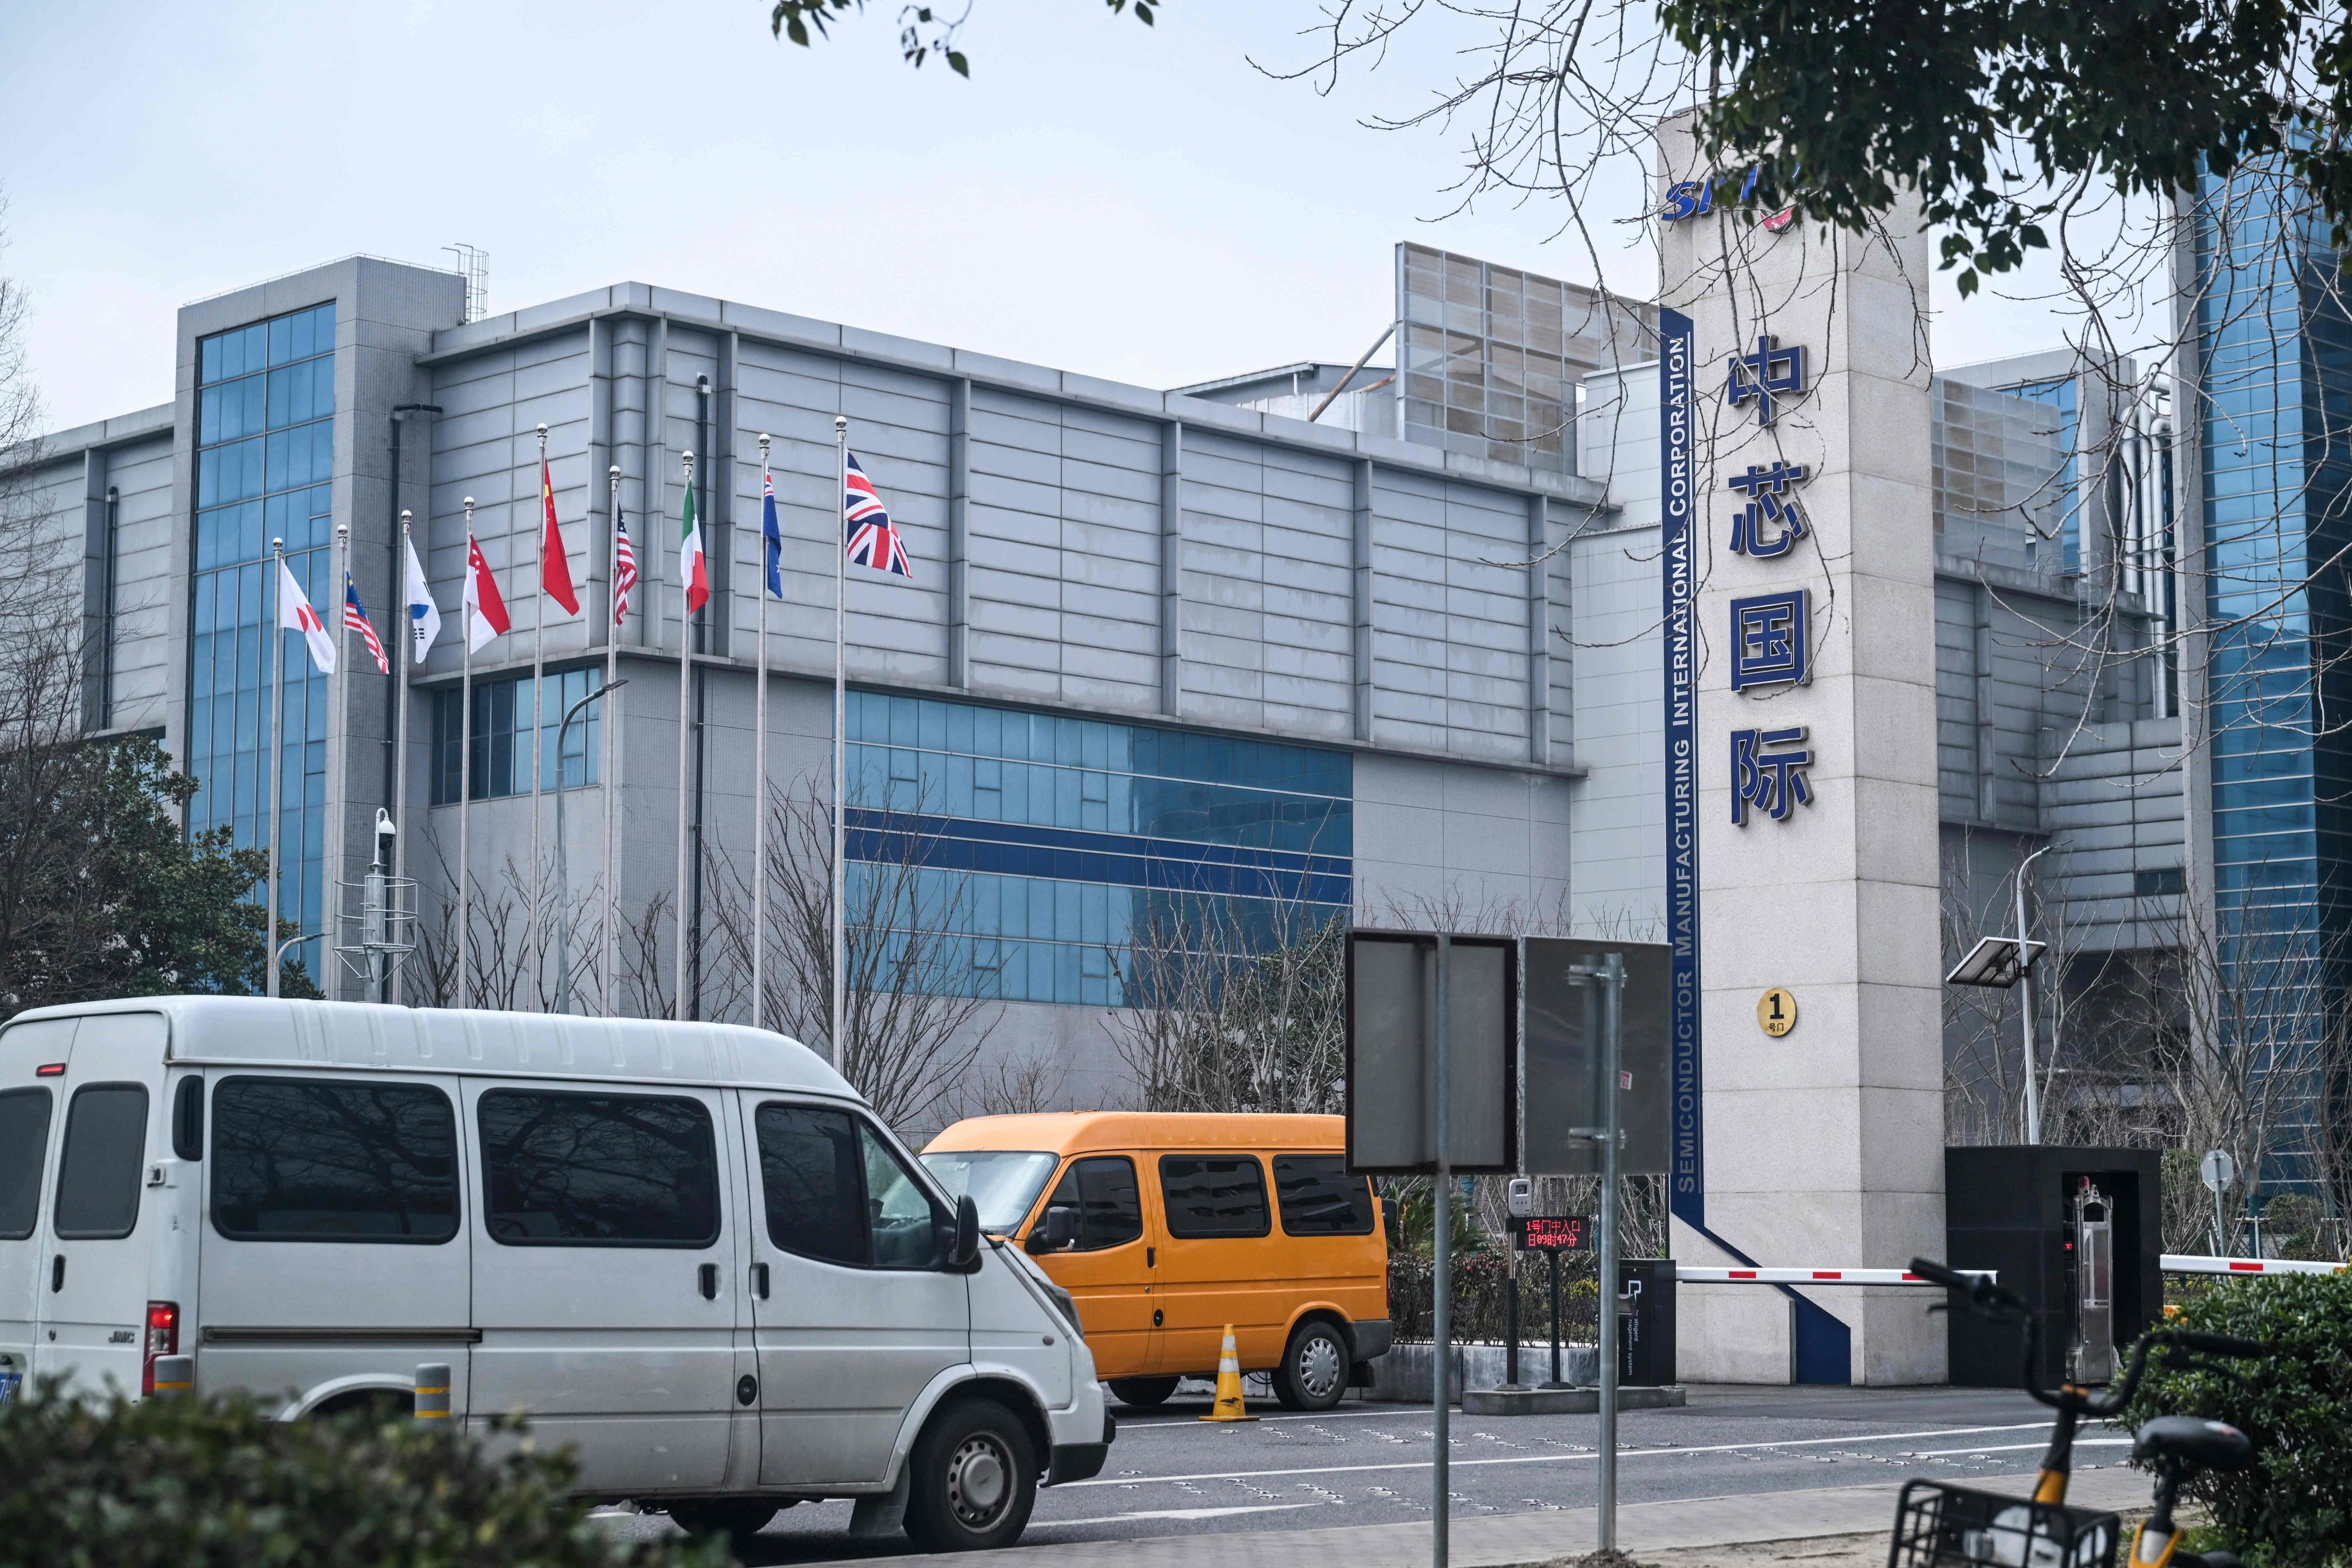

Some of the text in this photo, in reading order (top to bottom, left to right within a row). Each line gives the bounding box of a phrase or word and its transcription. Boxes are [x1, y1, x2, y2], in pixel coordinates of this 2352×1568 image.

[1728, 335, 1812, 825] 中芯国际
[1670, 337, 1694, 1194] SEMICONDUCTOR MANUFACTURING INTERNATIONAL CORPORATION
[1770, 992, 1785, 1019] 1
[1768, 1022, 1784, 1032] 号门
[1526, 1219, 1580, 1234] 1号门中入口
[1528, 1232, 1577, 1248] 日09时47分
[109, 1330, 135, 1343] JMC
